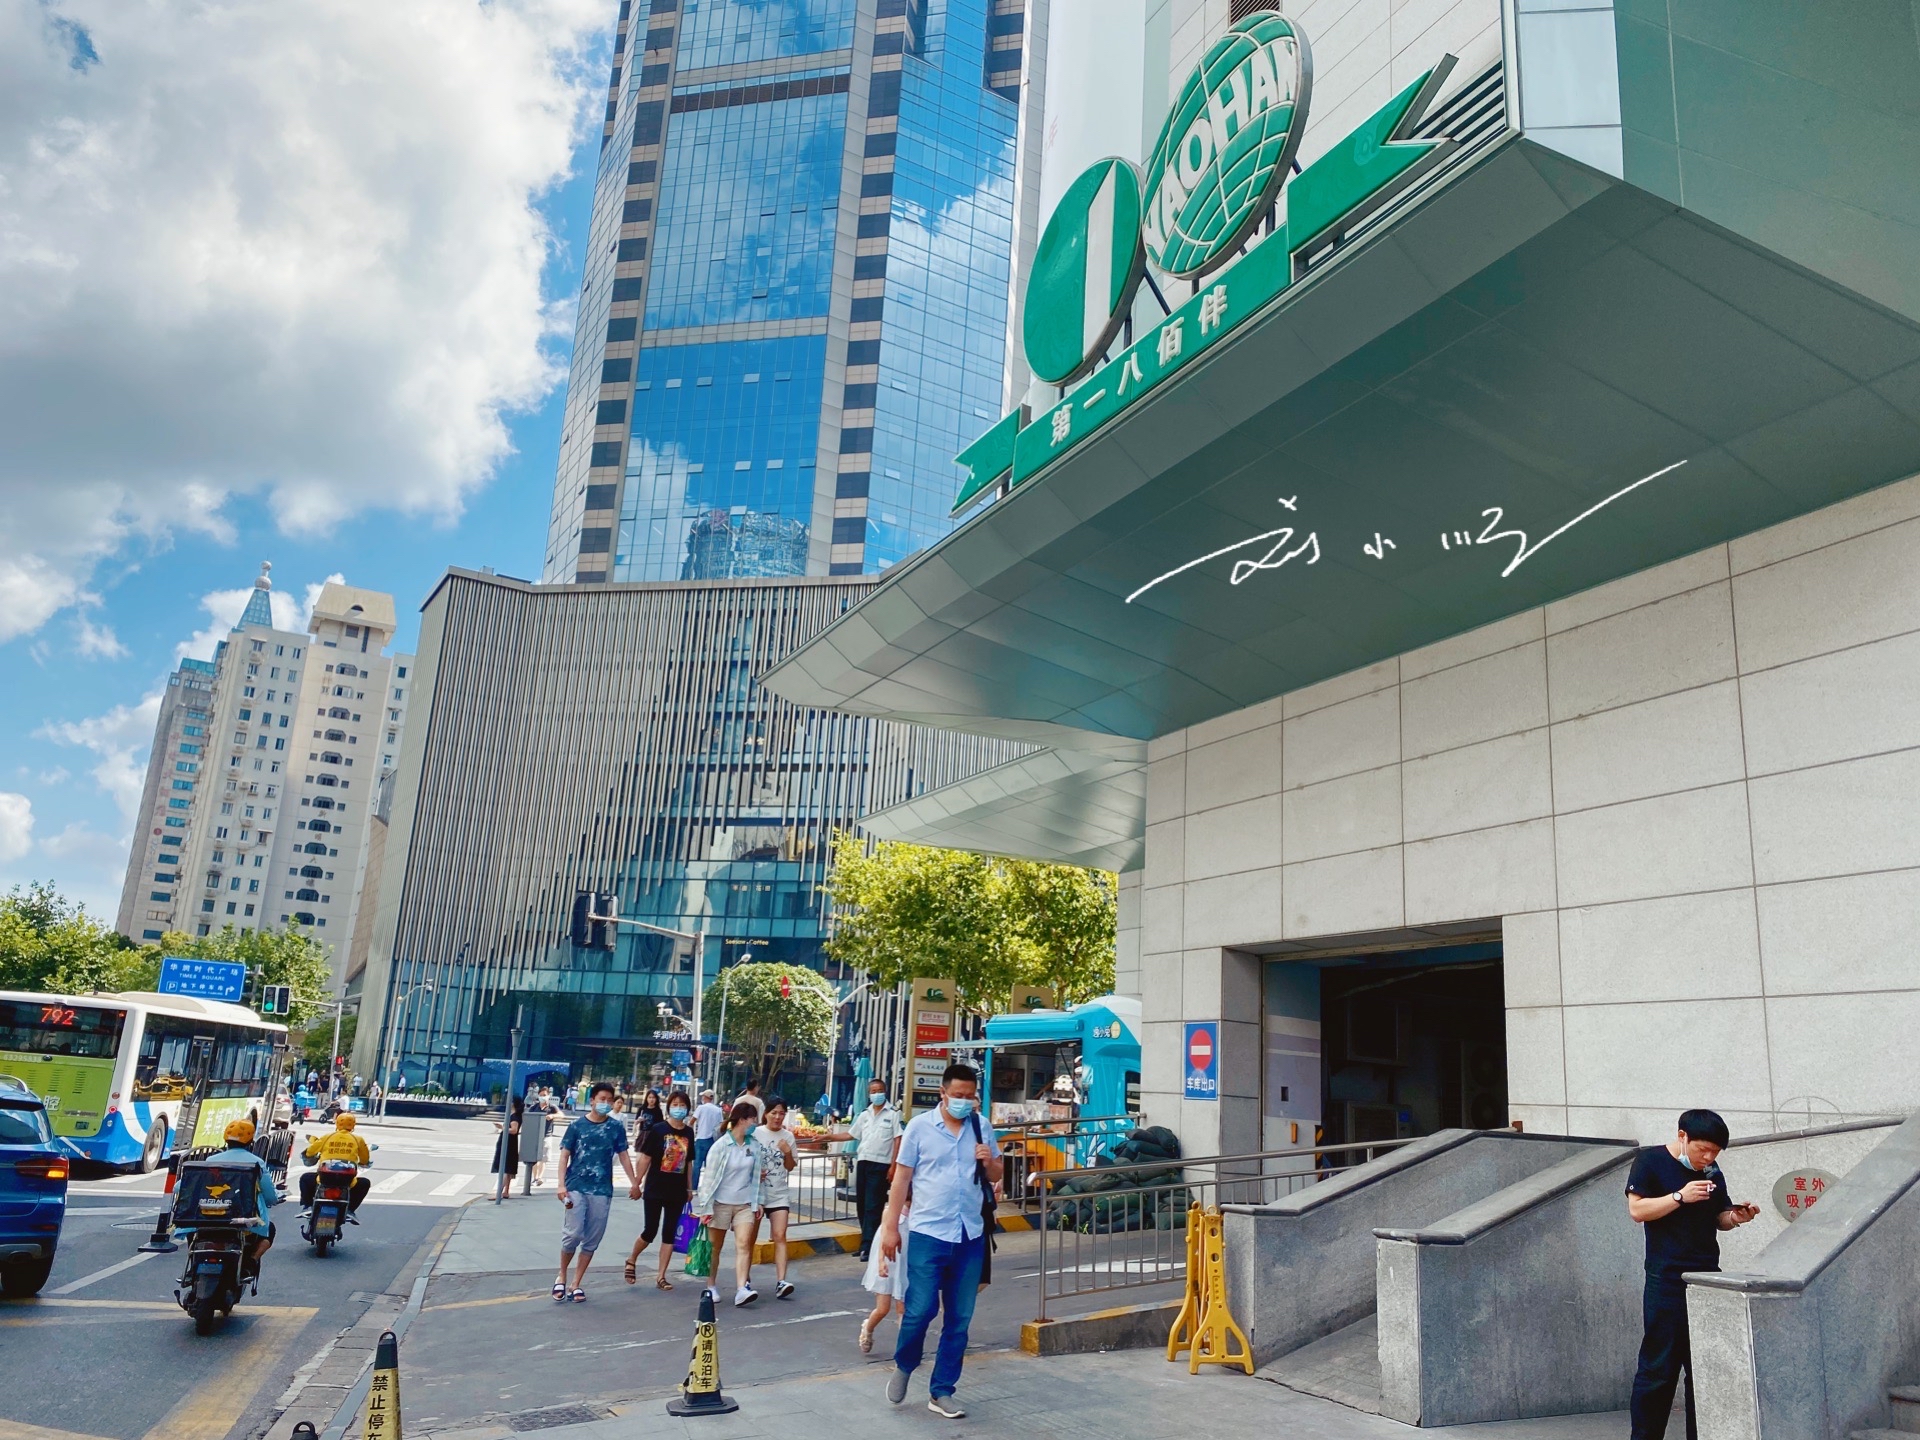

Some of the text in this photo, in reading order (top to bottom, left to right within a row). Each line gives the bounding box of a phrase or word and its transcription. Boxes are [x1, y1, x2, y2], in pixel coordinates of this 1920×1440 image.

[1143, 38, 1298, 265] YAOHAN
[1049, 285, 1228, 448] 第一八佰伴
[170, 963, 239, 977] 华润时代广场
[201, 974, 225, 982] SQUARE
[41, 1007, 75, 1025] 792
[653, 1030, 692, 1040] 华润时代广
[1186, 1076, 1215, 1092] 车库出口
[1793, 1176, 1825, 1193] 室外
[700, 1339, 713, 1389] 请勿泊车
